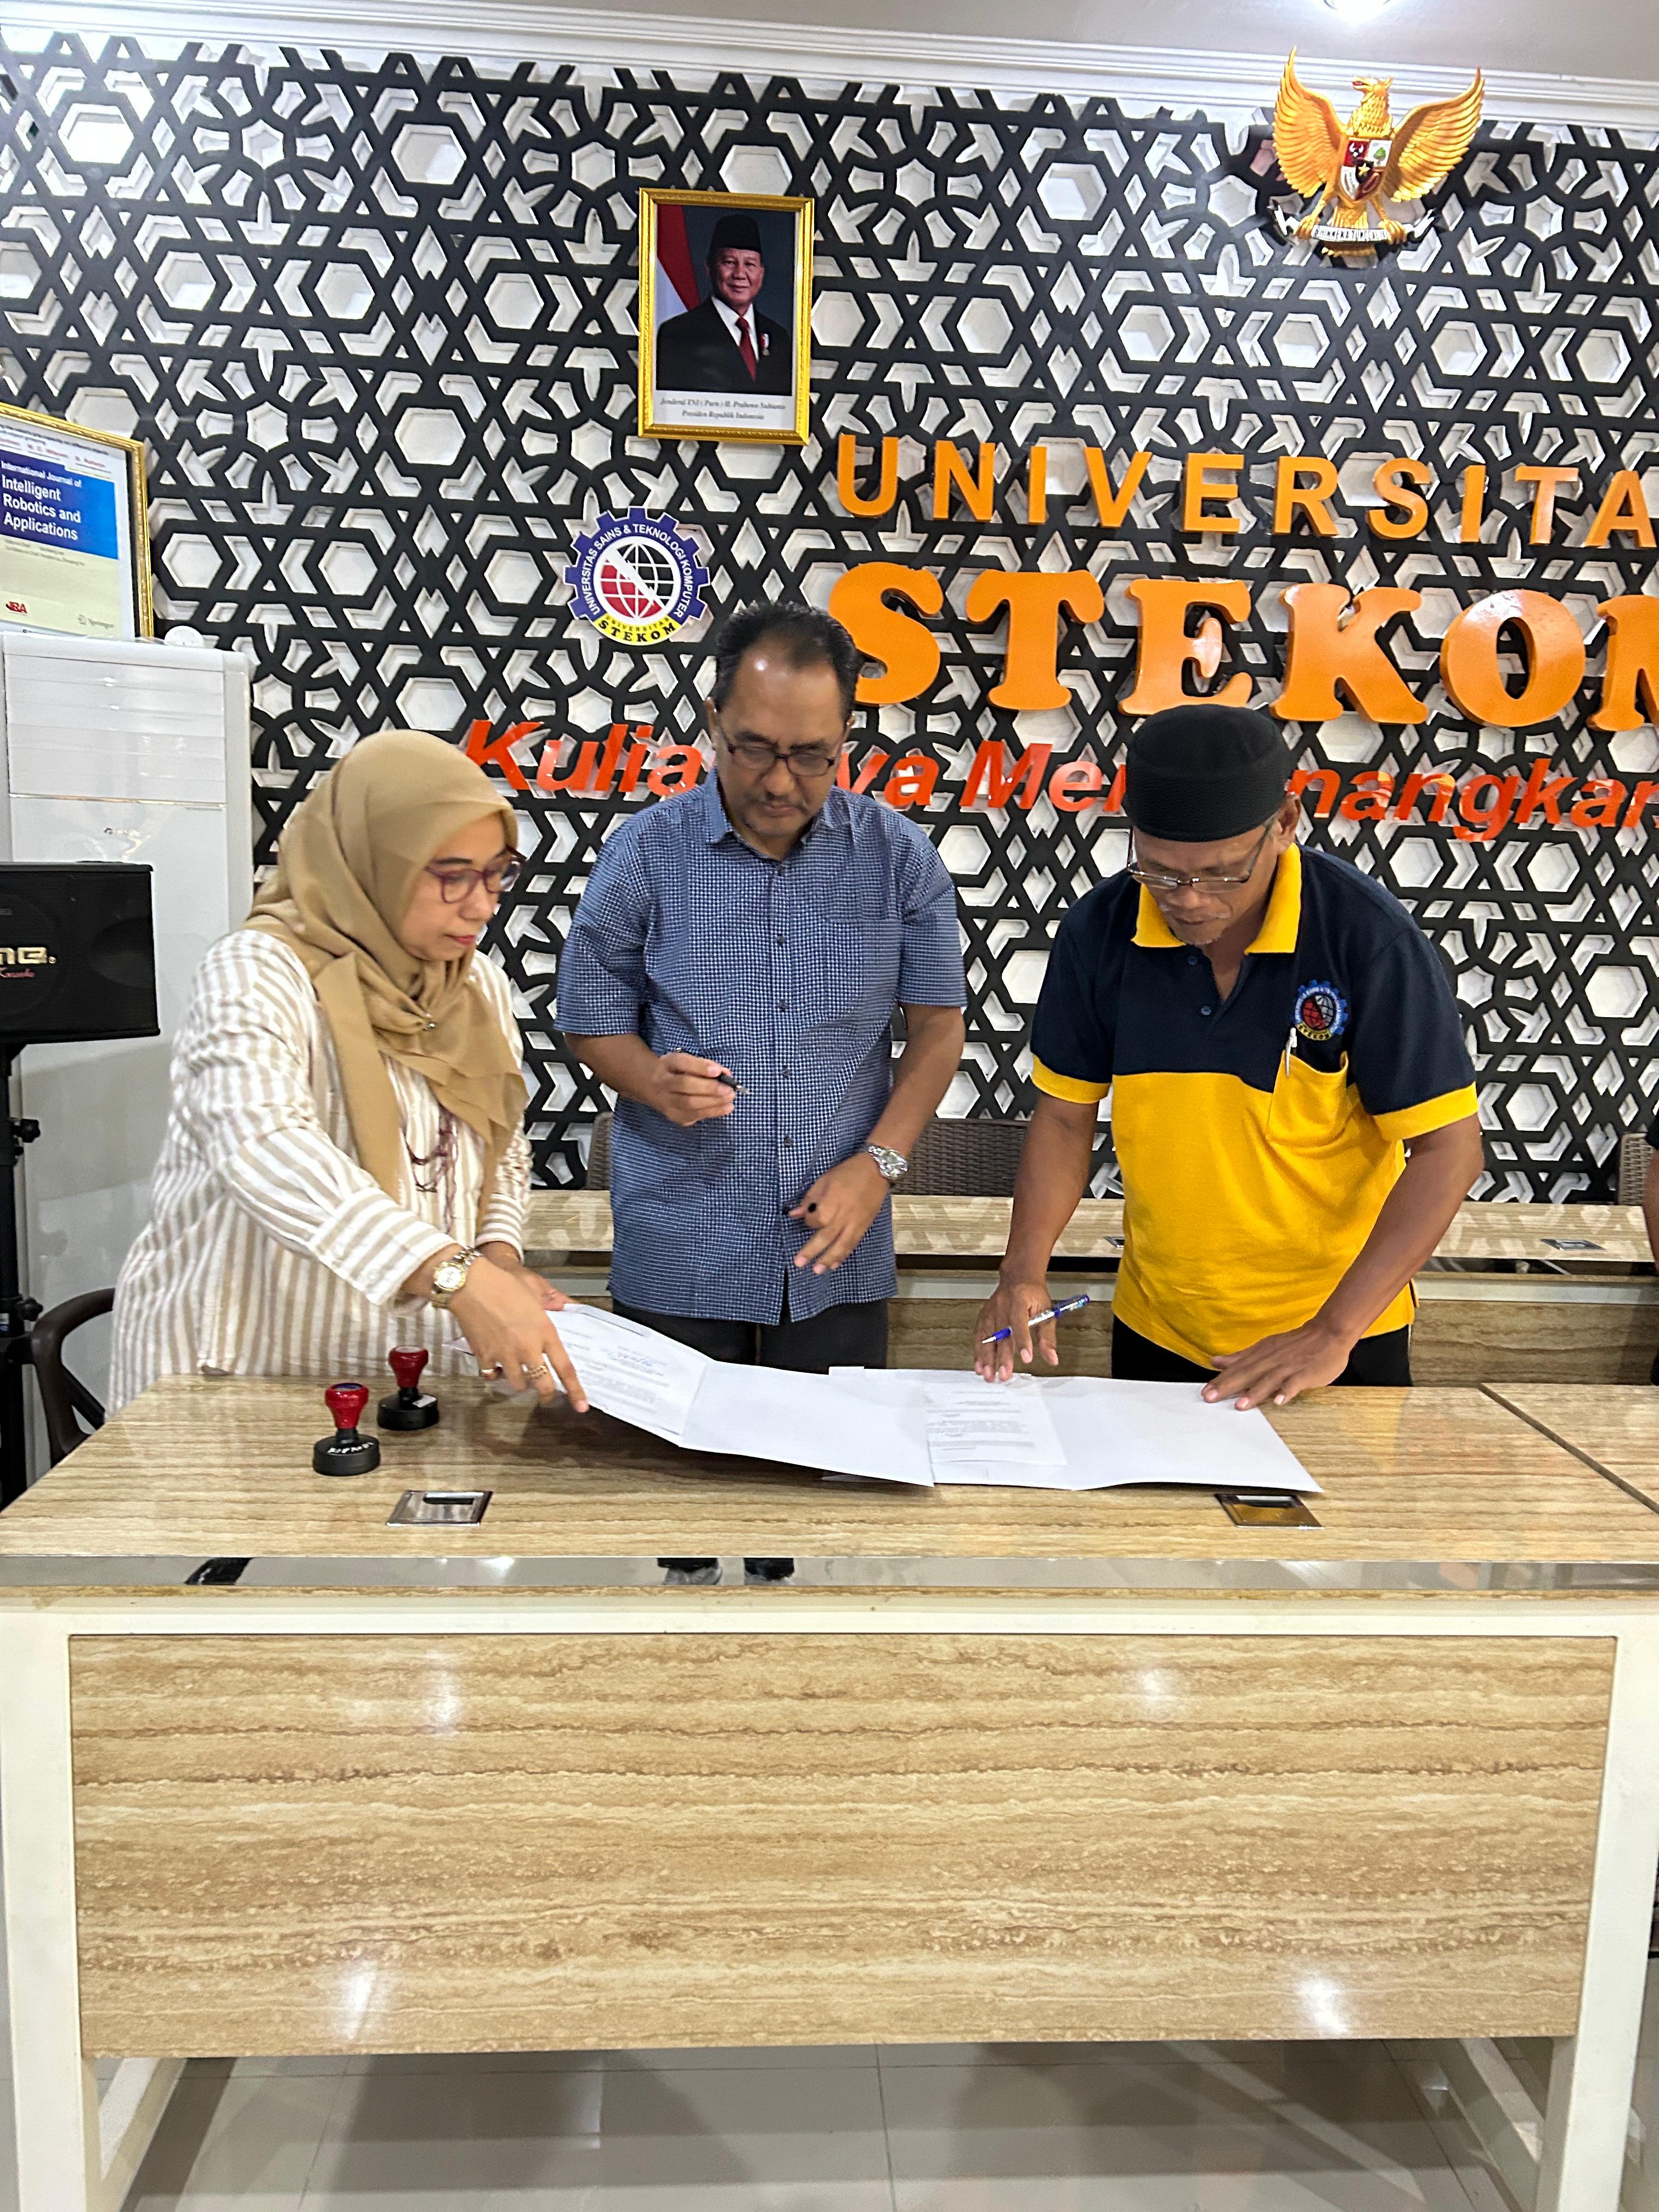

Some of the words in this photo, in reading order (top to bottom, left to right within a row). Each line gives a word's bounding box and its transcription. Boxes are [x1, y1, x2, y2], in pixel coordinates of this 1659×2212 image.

[1, 460, 45, 479] International
[47, 472, 73, 486] Journal
[74, 479, 82, 488] of
[2, 474, 61, 501] Intelligent
[3, 493, 57, 518] Robotics
[59, 509, 82, 523] and
[3, 511, 78, 540] Applications
[581, 548, 601, 616] UNIVERSITAS
[594, 526, 622, 550] SAINS
[623, 524, 631, 533] &
[632, 523, 686, 560] TEKNOLOGI
[673, 559, 693, 618] KOMPUTER
[598, 622, 676, 642] STEKOM
